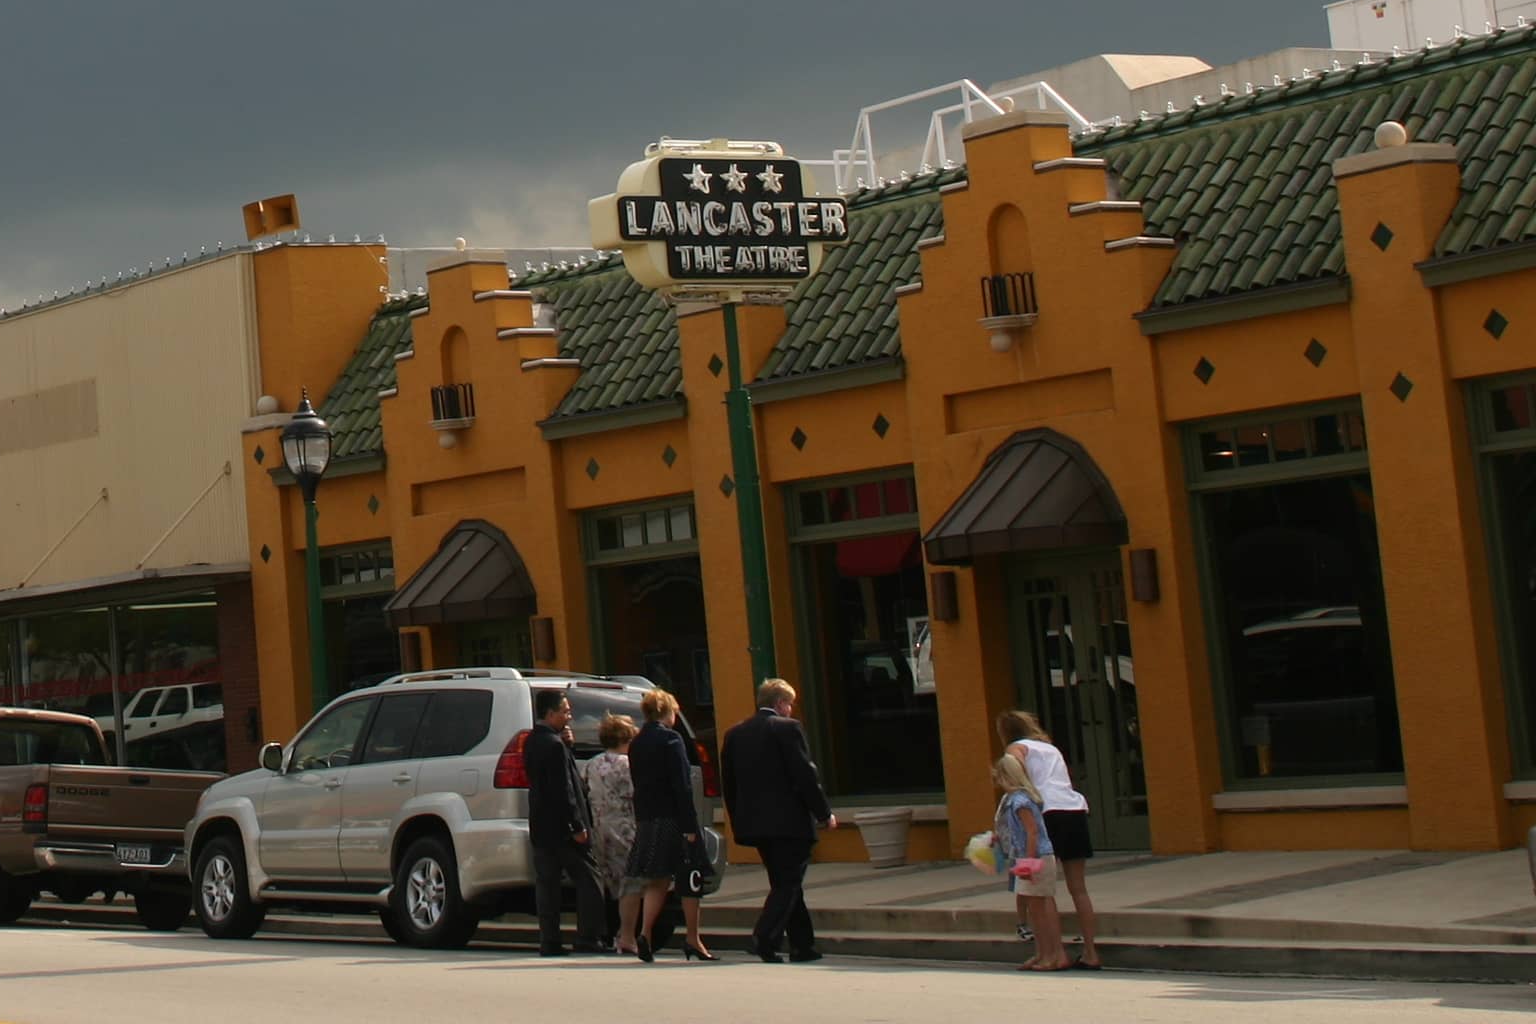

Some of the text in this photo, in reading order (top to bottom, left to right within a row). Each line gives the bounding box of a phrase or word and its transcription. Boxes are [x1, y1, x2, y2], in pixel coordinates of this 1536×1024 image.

[625, 201, 846, 236] LANCASTER
[675, 245, 808, 273] THEATRE
[55, 786, 111, 796] DODGE
